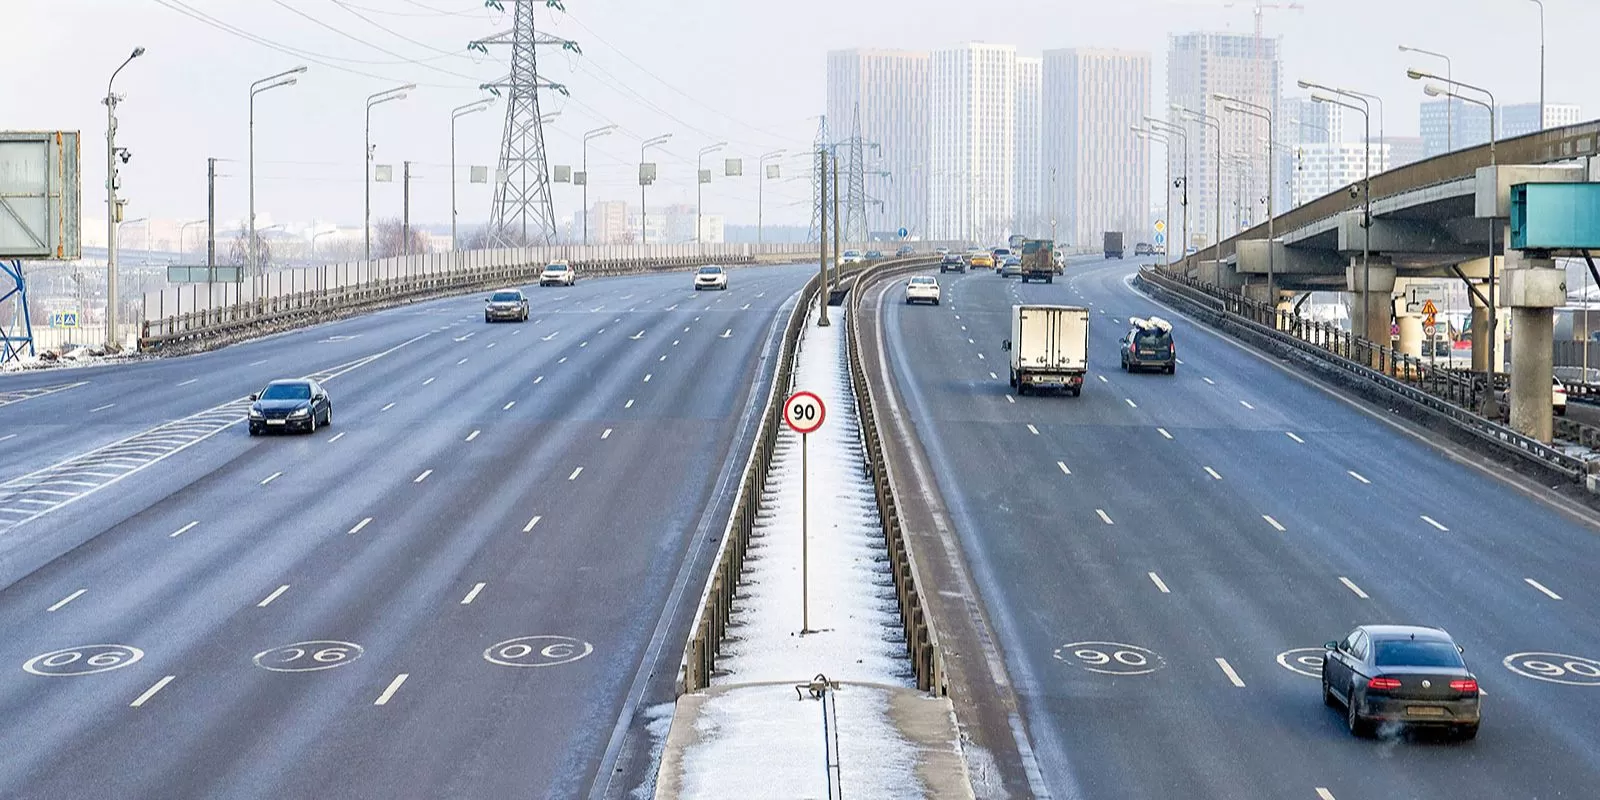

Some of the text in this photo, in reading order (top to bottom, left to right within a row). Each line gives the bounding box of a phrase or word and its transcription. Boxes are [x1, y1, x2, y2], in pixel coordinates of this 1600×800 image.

[793, 404, 815, 420] 90
[43, 652, 127, 666] 90
[1075, 650, 1147, 665] 90
[1298, 656, 1324, 671] 9
[1523, 661, 1600, 676] 90
